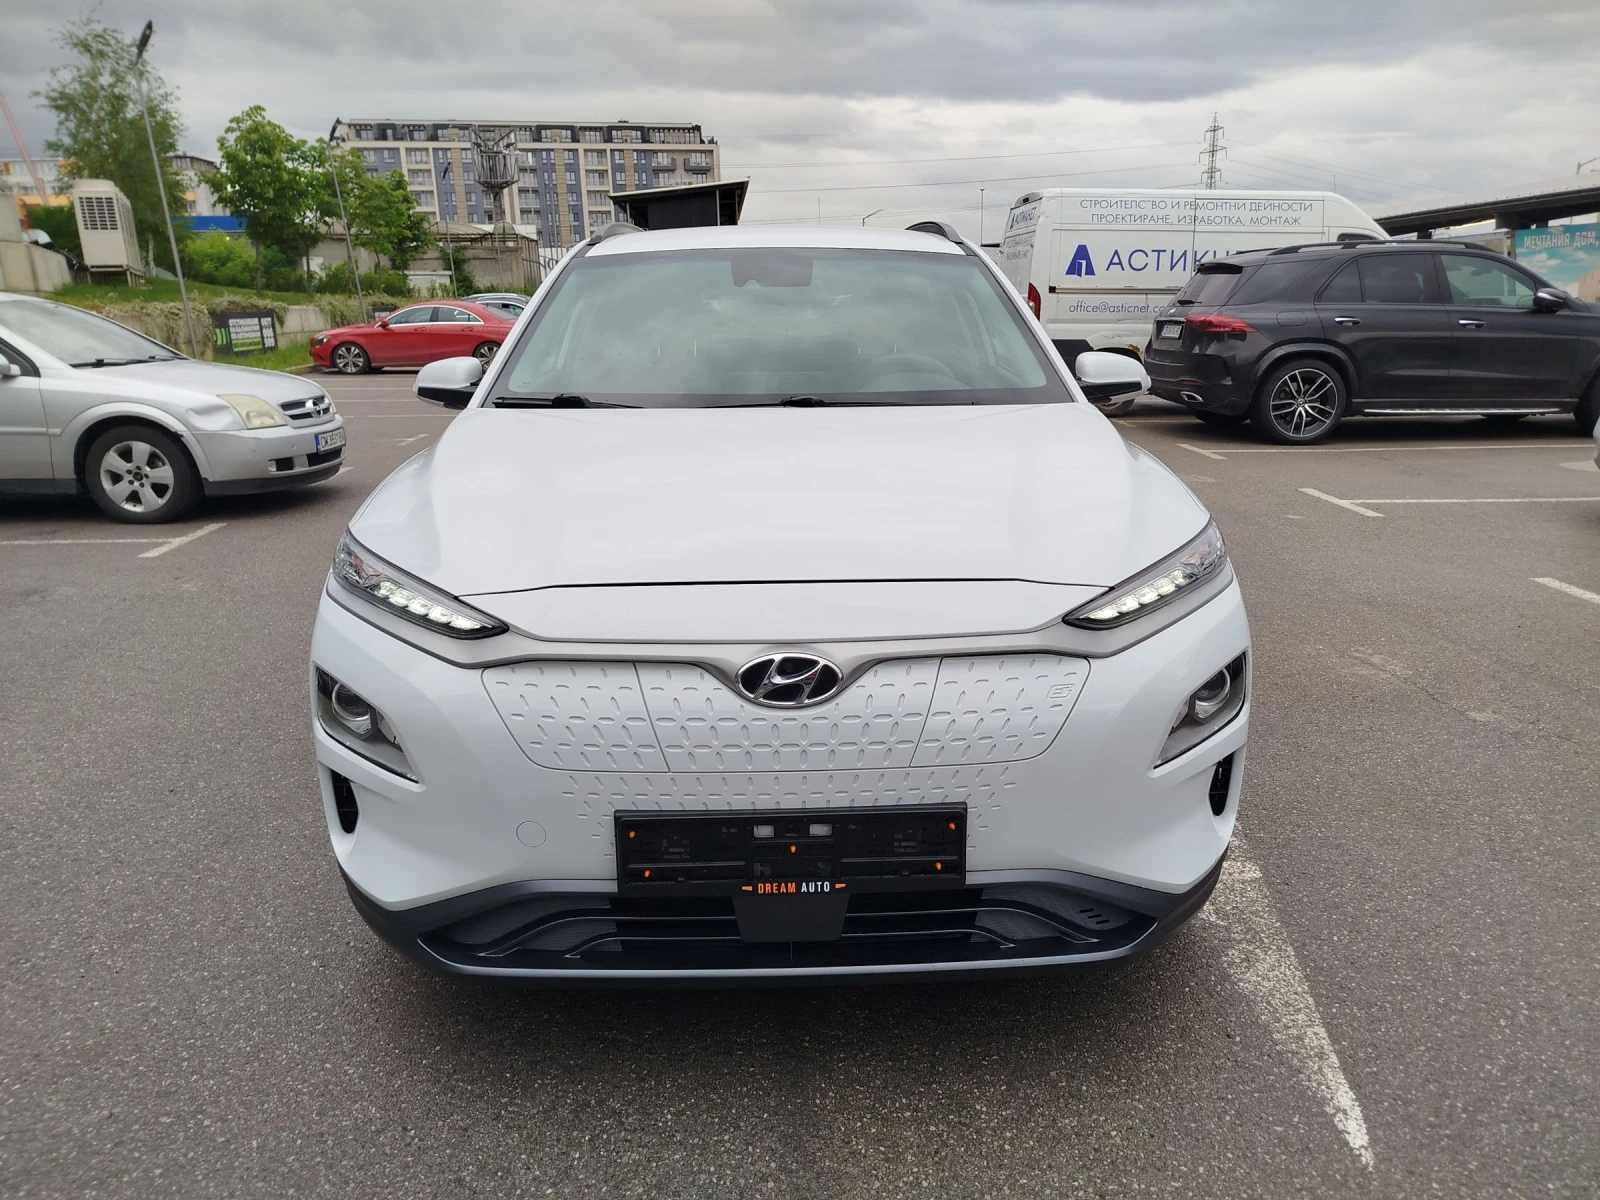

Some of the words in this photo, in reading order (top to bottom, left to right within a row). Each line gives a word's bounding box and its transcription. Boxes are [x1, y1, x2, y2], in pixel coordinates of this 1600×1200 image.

[1171, 200, 1180, 210] И
[1183, 200, 1246, 211] РЕМОНТНИ
[1249, 200, 1313, 212] ДЕЙНОСТИ
[1091, 213, 1174, 225] ПРОЕКТИРАНЕ,
[1177, 214, 1246, 226] ИЗРАБОТКА,
[1249, 216, 1302, 226] МОНТАЖ
[1524, 233, 1570, 249] МЕЧТАНИЯ
[757, 882, 796, 894] DREAM
[801, 881, 830, 893] AUTO
